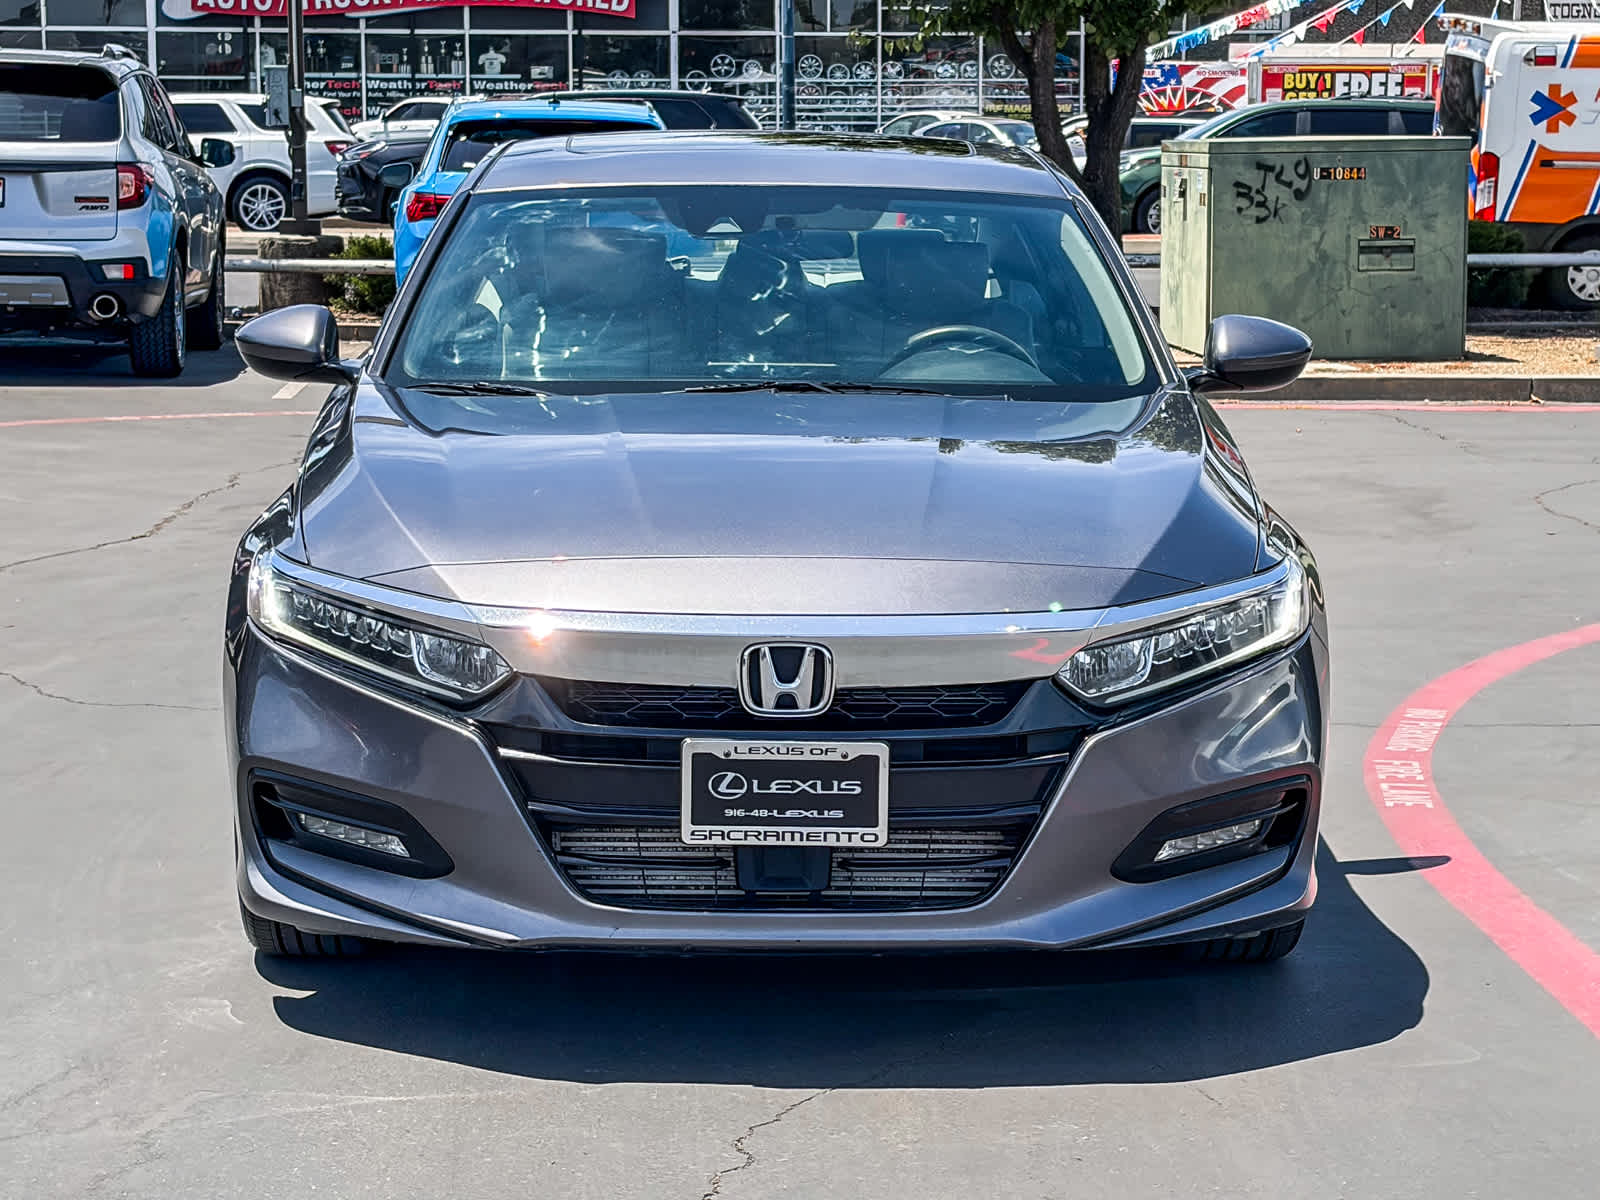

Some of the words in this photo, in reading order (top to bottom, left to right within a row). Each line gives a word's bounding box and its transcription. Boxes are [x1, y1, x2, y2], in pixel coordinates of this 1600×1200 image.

[473, 80, 568, 90] WeatherTech
[1284, 73, 1317, 89] BUY
[1324, 73, 1332, 89] 1
[1312, 167, 1367, 181] U-10844
[1369, 226, 1401, 239] SW-2
[733, 746, 805, 756] LEXUS
[809, 747, 838, 756] OF
[751, 779, 863, 796] LEXUS
[689, 829, 880, 844] SACRAMENTO
